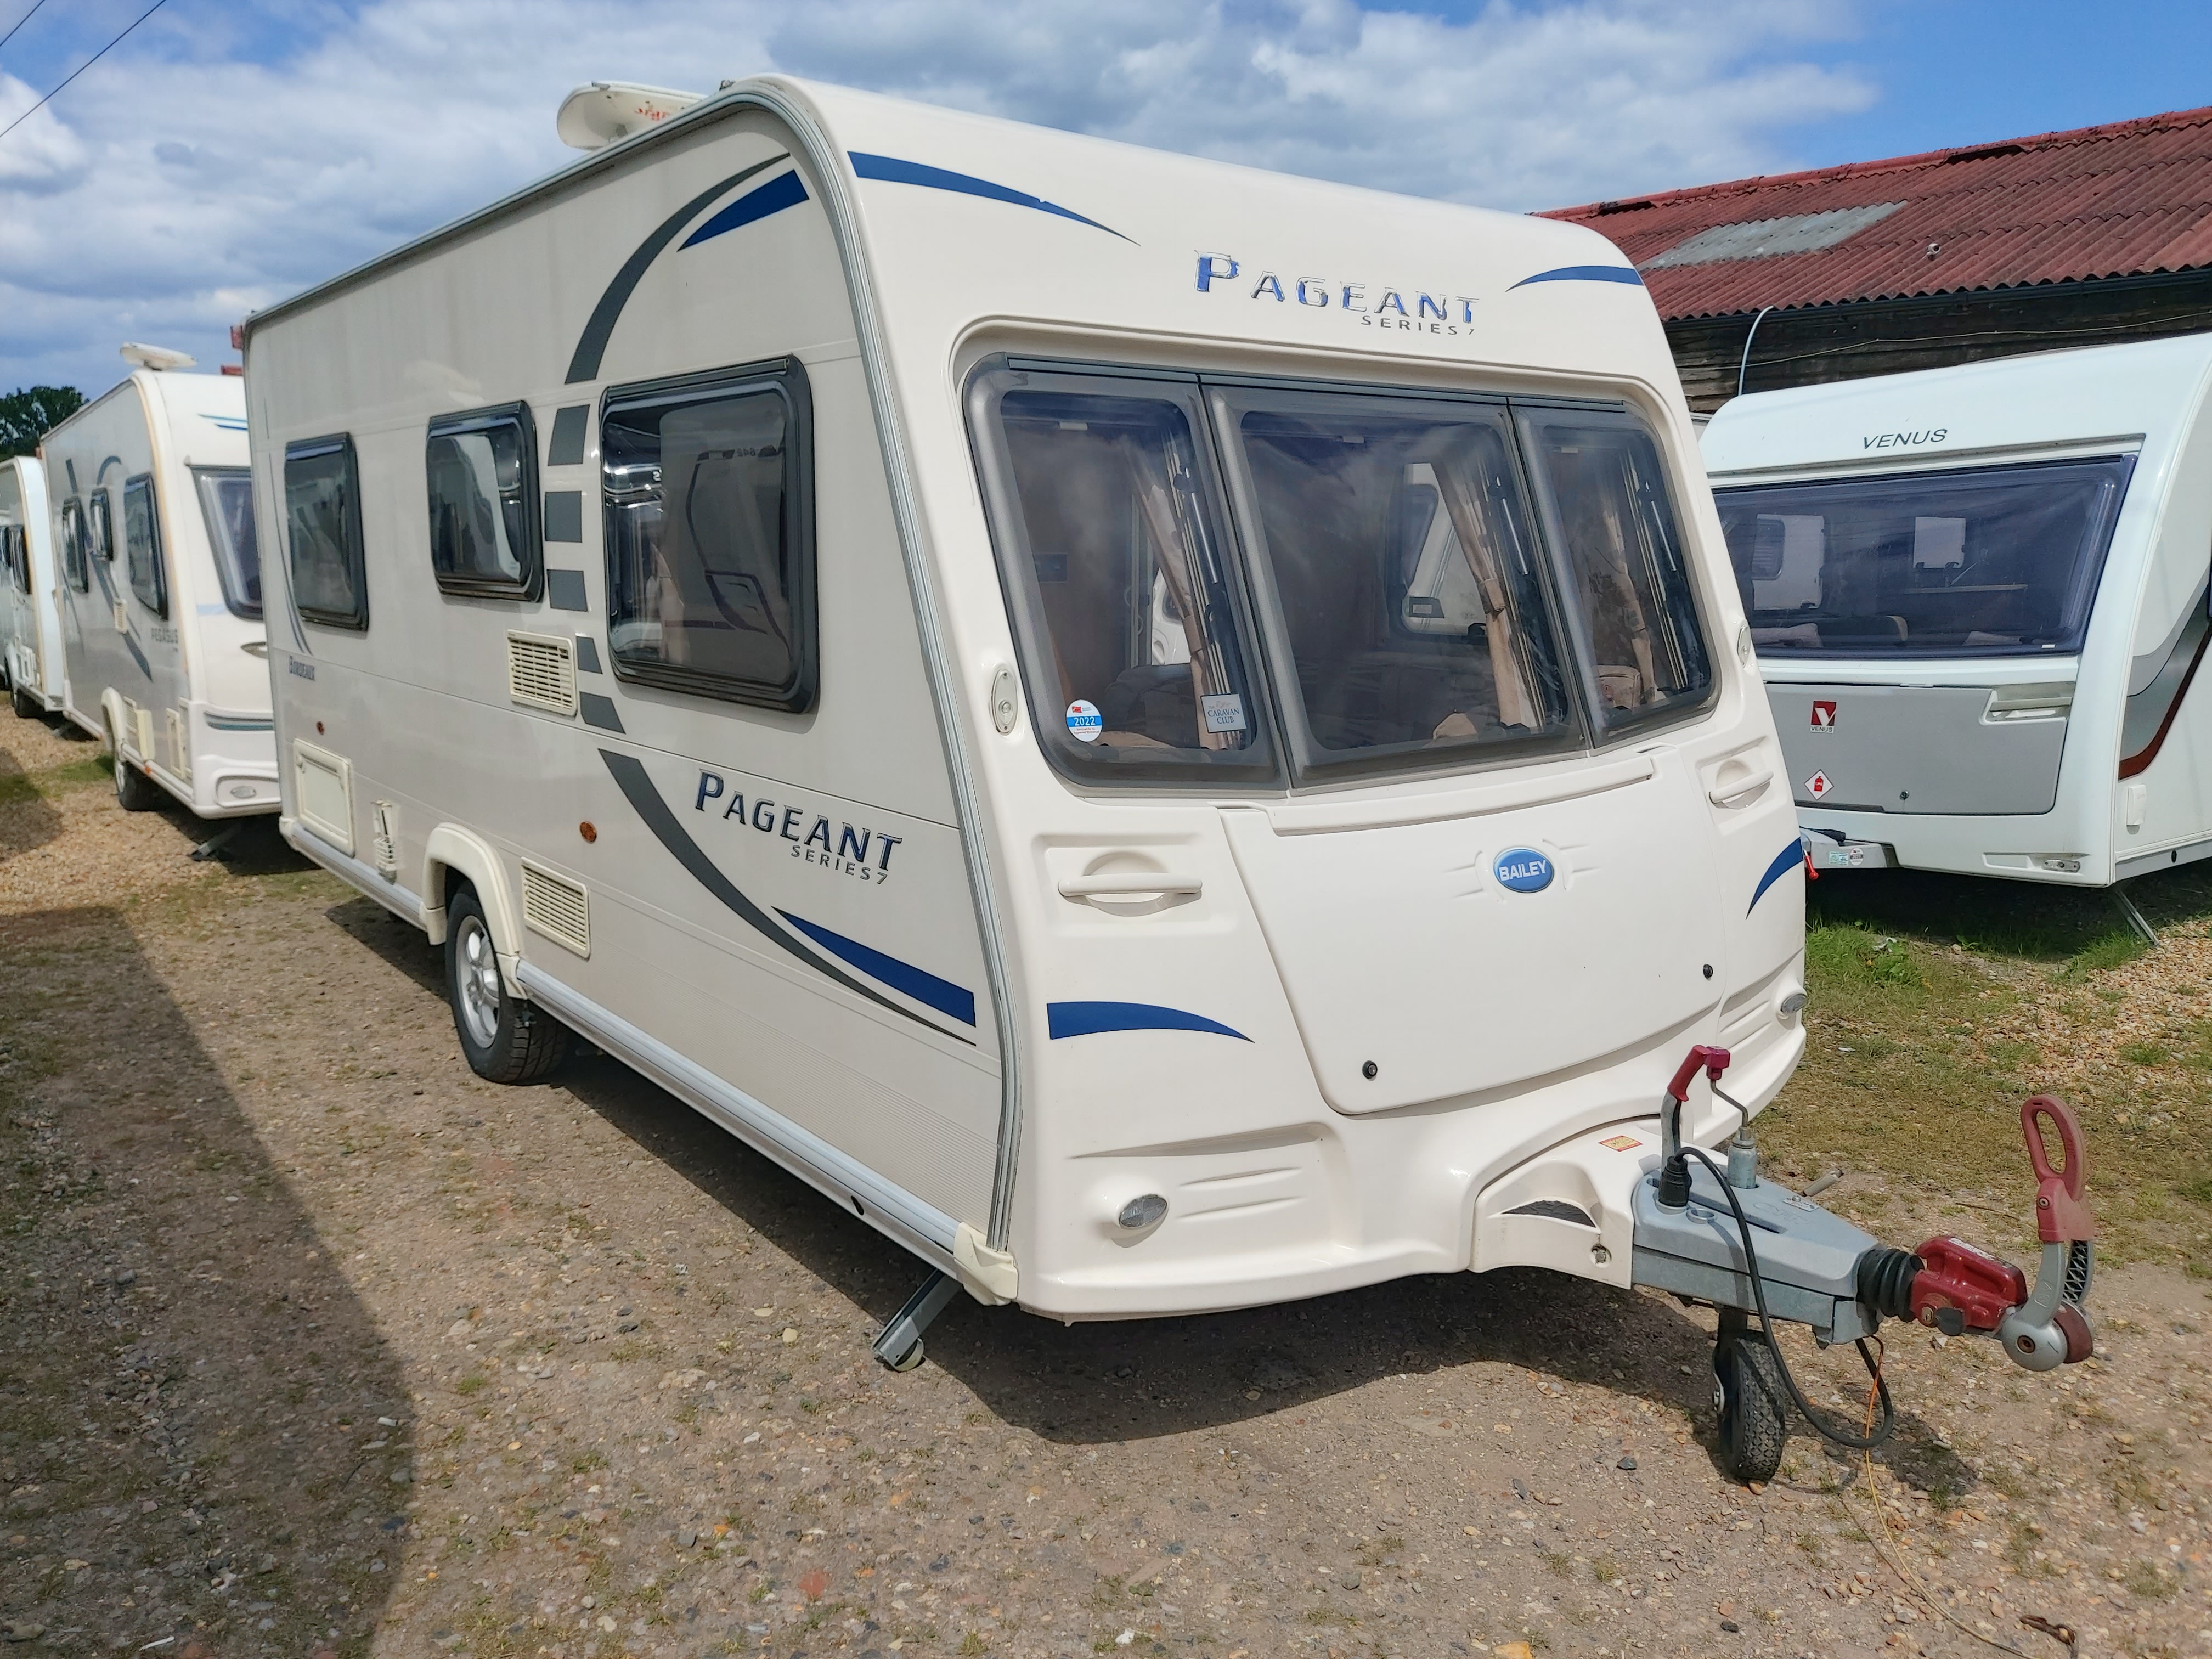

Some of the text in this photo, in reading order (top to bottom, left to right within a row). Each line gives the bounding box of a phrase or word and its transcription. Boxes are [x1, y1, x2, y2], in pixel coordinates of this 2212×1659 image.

[1194, 250, 1480, 324] PAGEANT
[1864, 428, 1948, 449] VENUS
[1074, 716, 1096, 726] 2022
[1207, 708, 1239, 717] CARAVAN
[695, 768, 902, 871] PAGEANT
[1499, 860, 1546, 881] BAILEY
